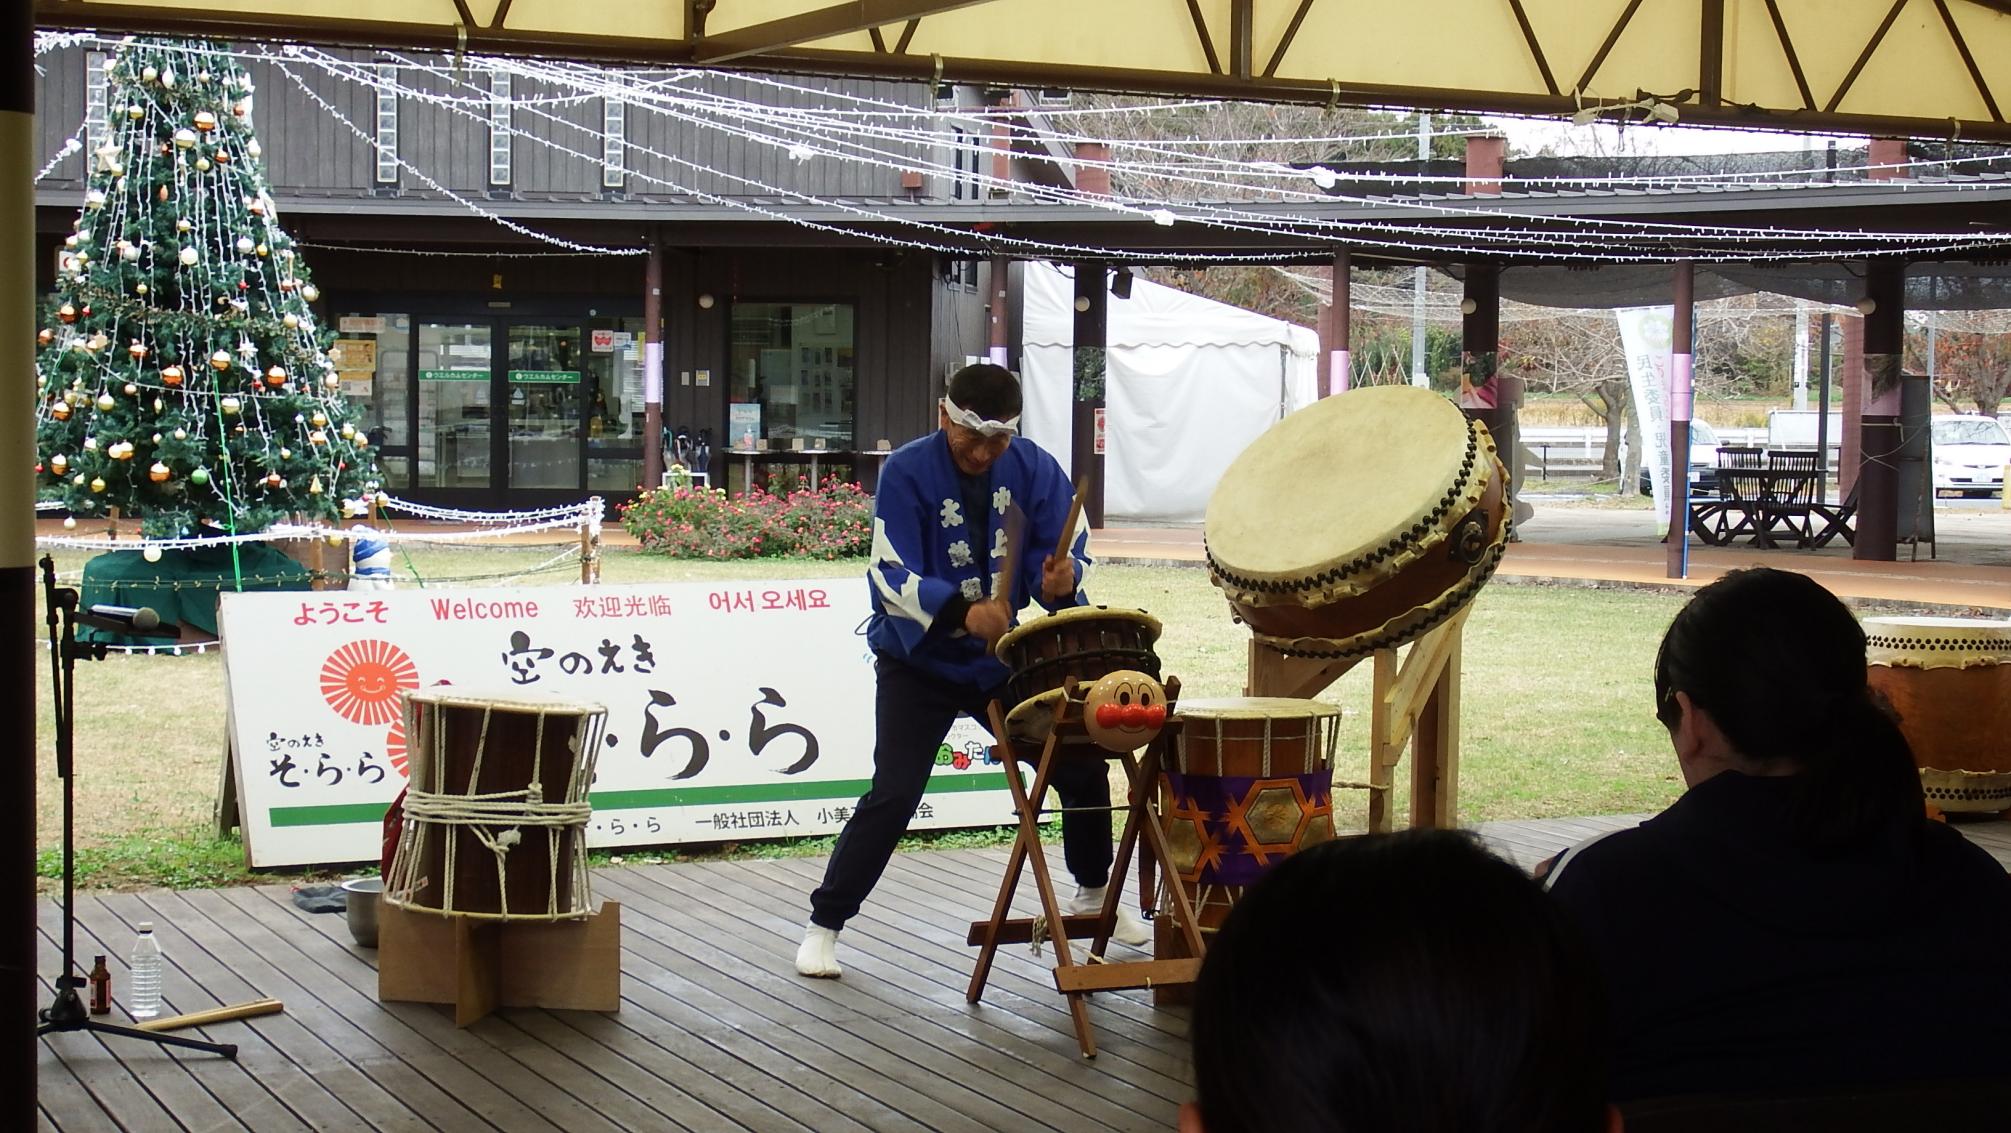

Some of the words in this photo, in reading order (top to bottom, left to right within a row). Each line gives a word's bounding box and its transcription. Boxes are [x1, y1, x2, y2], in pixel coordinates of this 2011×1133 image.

[293, 600, 389, 626] ようこそ
[430, 597, 539, 621] Welcome
[573, 594, 672, 619] 欢迎光临
[708, 590, 755, 614] 어서
[761, 588, 831, 611] 오세요
[501, 630, 656, 685] 空のえき
[591, 687, 819, 780] ・ら・ら
[595, 816, 661, 836] ・ら・ら
[695, 808, 800, 830] 一般社団法人
